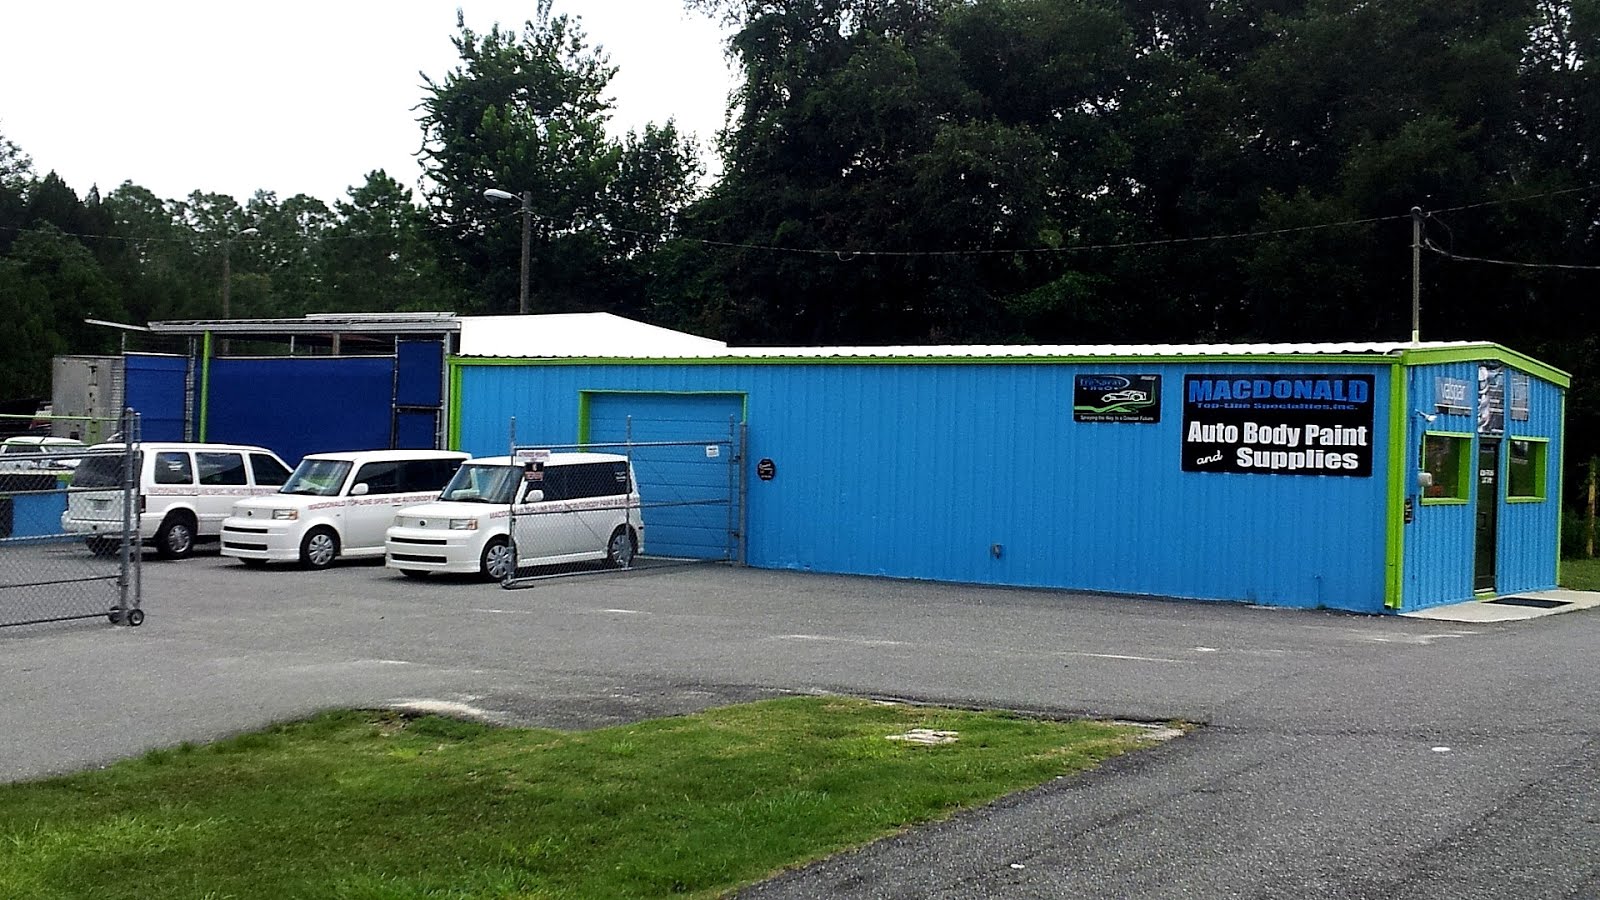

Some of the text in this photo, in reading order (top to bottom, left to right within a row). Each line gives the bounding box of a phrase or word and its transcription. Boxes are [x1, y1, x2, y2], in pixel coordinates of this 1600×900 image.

[1188, 379, 1369, 403] MACDONALD
[1187, 421, 1368, 448] Auto Body Paint
[1196, 447, 1359, 470] and Supplies
